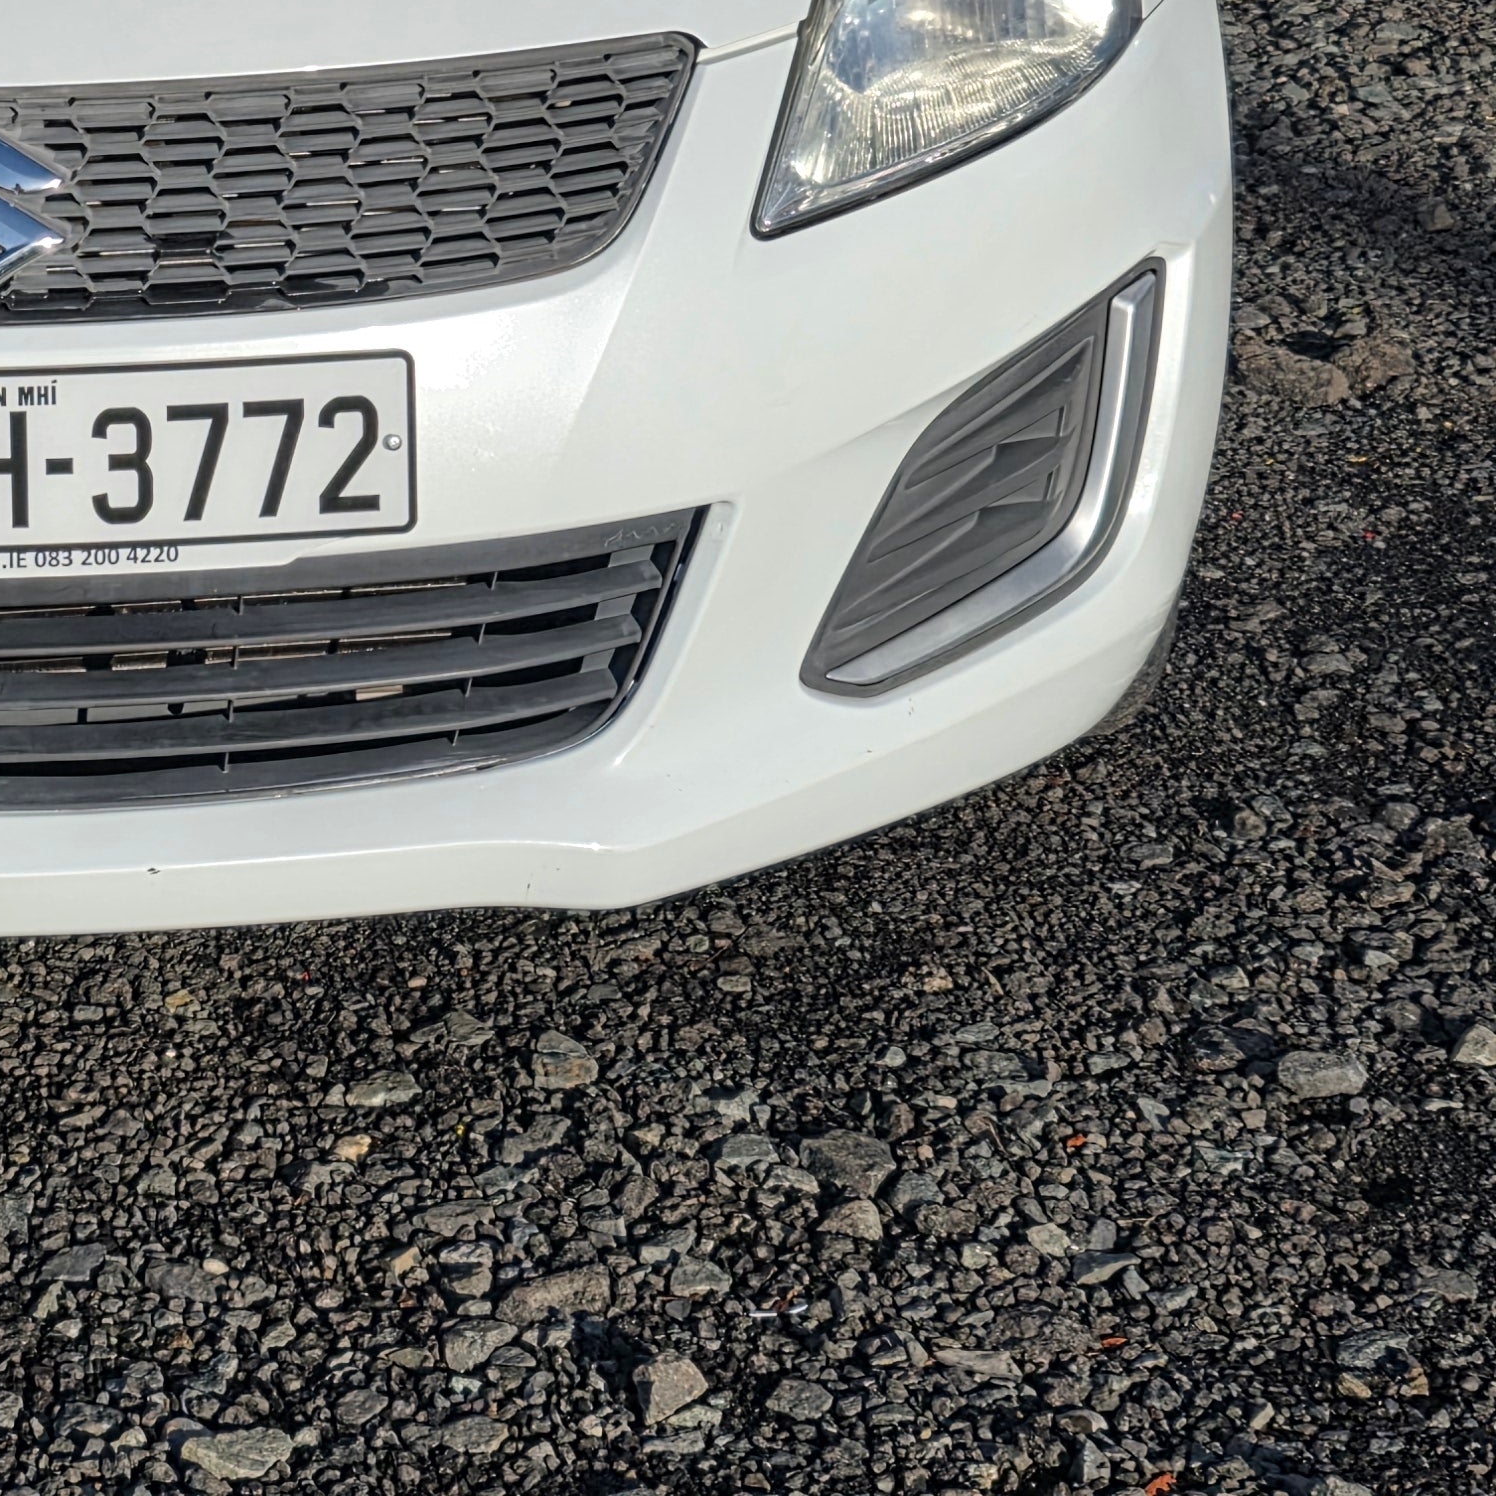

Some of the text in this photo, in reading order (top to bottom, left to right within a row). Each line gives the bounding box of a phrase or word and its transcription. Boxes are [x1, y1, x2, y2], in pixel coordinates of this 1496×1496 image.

[18, 379, 58, 406] MHÍ
[34, 549, 73, 568] 083
[80, 548, 120, 566] 200
[126, 545, 180, 564] 4220
